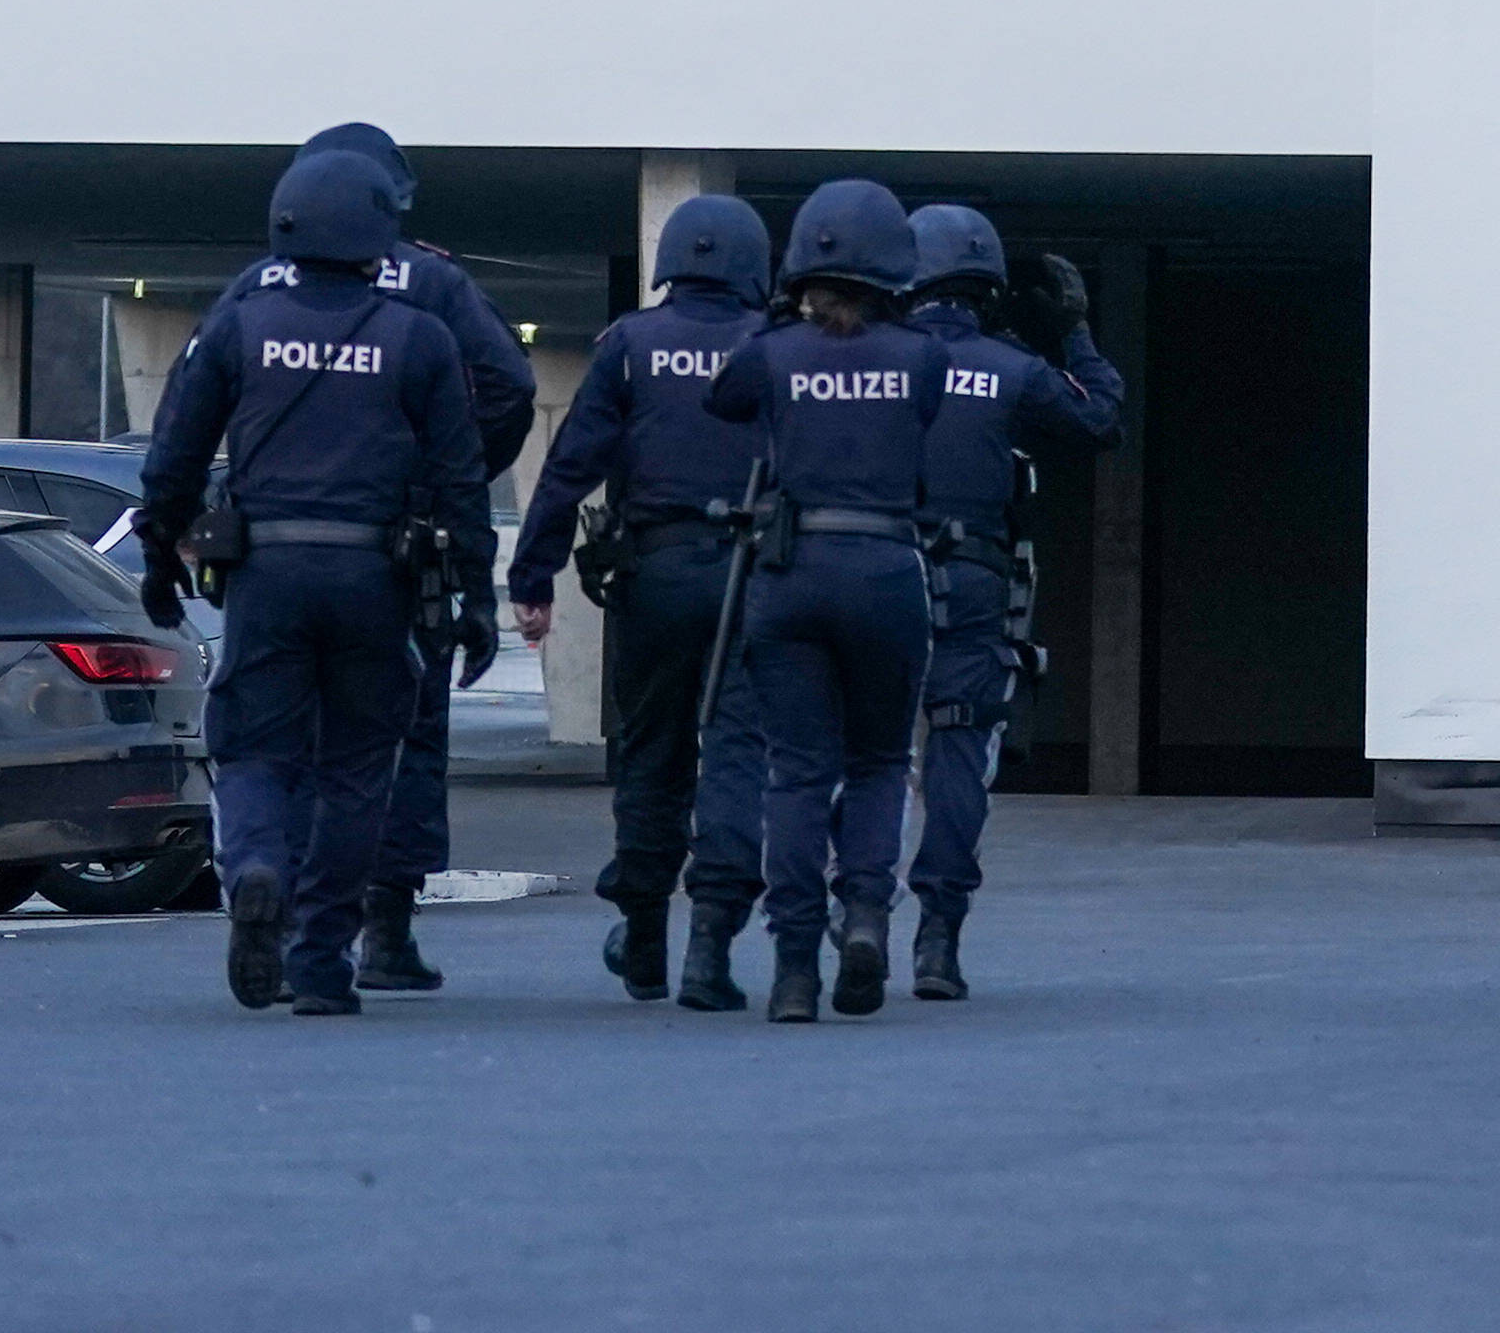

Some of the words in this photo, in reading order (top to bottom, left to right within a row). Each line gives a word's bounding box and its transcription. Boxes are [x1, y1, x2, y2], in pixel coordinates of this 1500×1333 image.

[263, 340, 383, 375] POLIZEI
[651, 350, 730, 382] POLI
[790, 370, 910, 402] POLIZEI
[945, 368, 999, 400] IZEI
